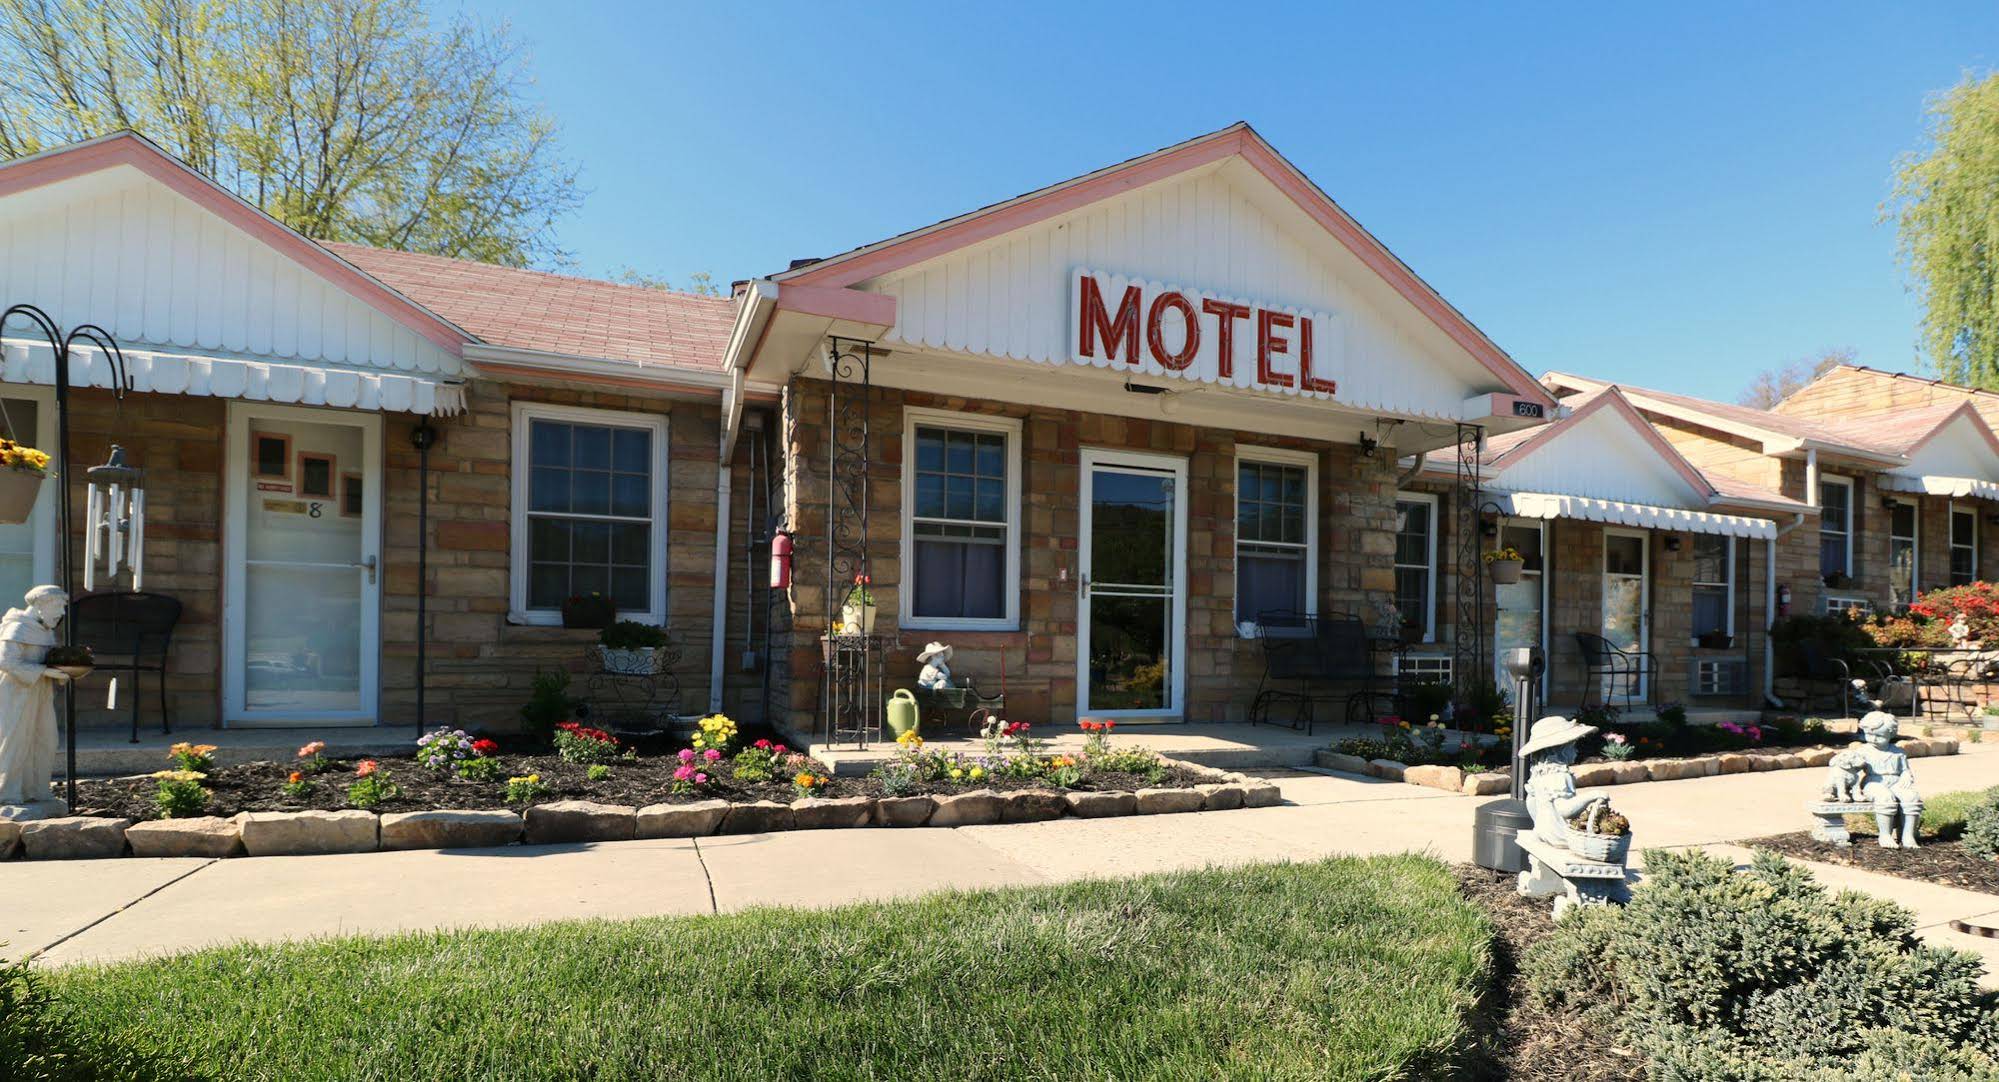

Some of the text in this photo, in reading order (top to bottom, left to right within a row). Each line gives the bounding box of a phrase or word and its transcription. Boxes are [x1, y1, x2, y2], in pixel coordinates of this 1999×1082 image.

[1080, 275, 1336, 394] MOTEL
[1520, 403, 1538, 417] 600
[309, 502, 323, 518] 8
